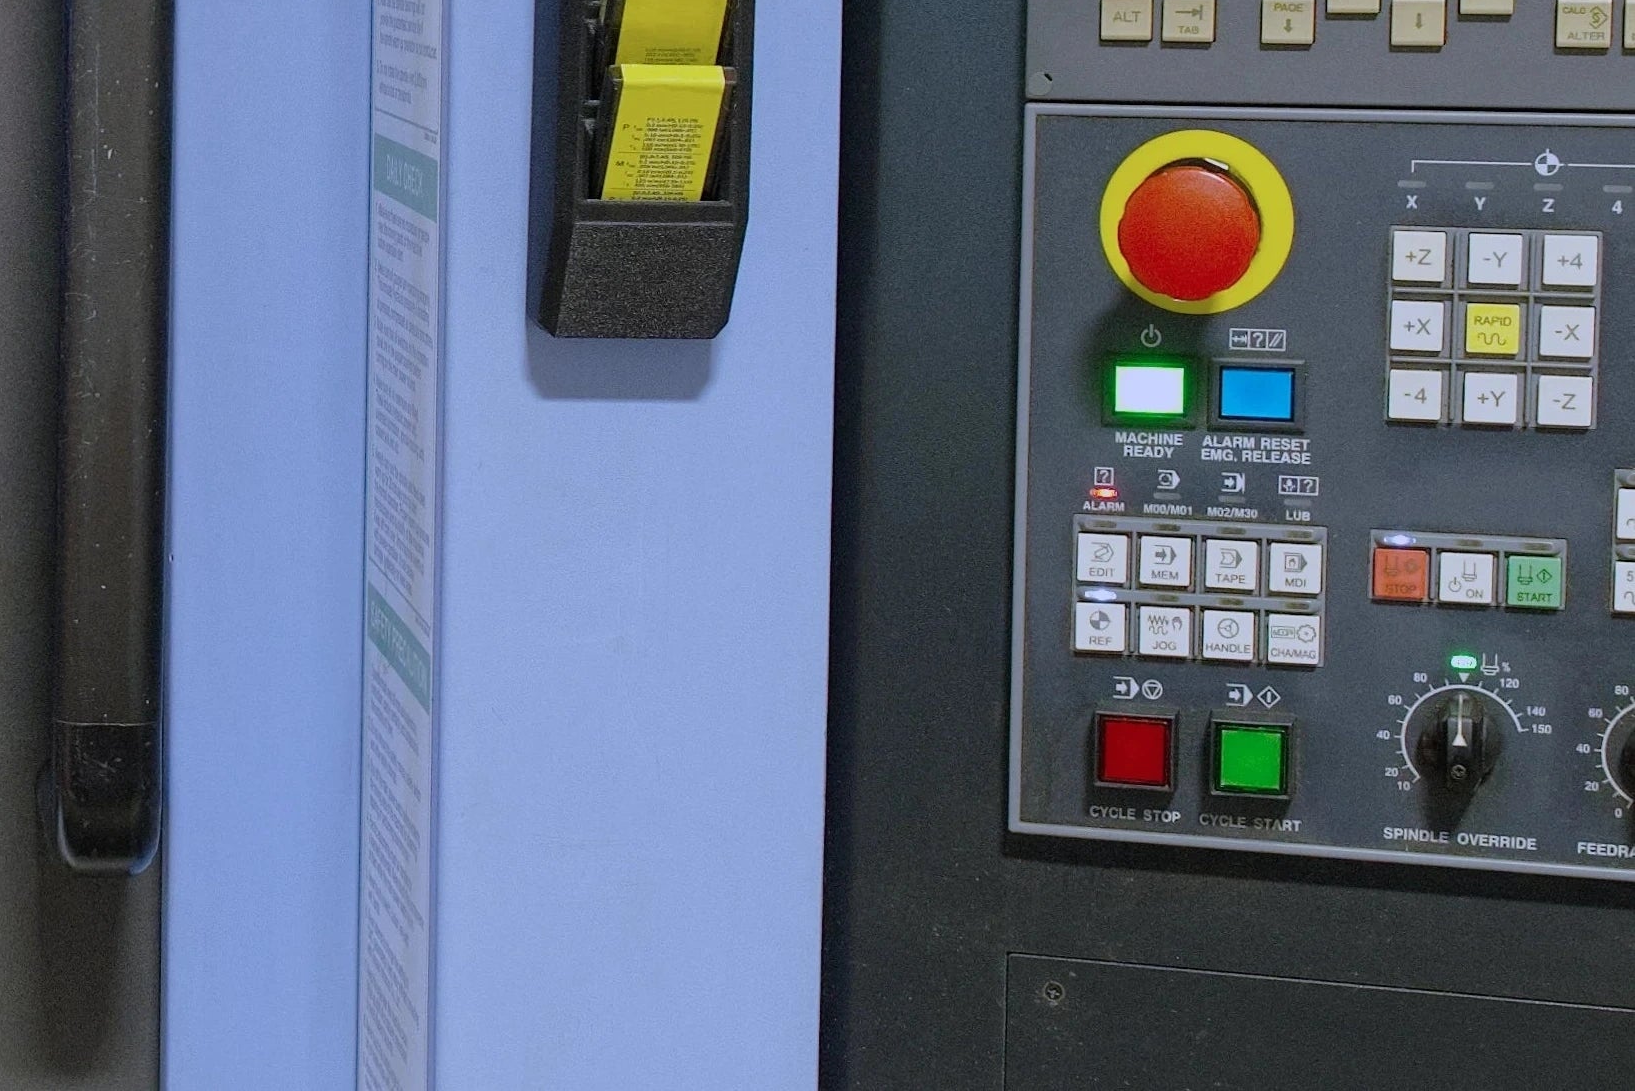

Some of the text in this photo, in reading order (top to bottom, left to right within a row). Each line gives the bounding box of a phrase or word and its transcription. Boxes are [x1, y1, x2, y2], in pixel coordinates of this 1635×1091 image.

[1113, 11, 1141, 23] ALT
[1178, 25, 1200, 34] TAB
[1567, 32, 1605, 41] ALTER
[1406, 195, 1418, 210] X
[1474, 196, 1486, 211] Y
[1542, 198, 1555, 213] Z
[1611, 200, 1623, 214] 4
[1405, 248, 1432, 266] +Z
[1482, 251, 1508, 268] -Y
[1556, 253, 1584, 270] +4
[1403, 318, 1432, 335] +X
[1473, 315, 1512, 327] RAPID
[1554, 324, 1581, 341] -X
[1404, 387, 1427, 404] -4
[1477, 390, 1506, 408] +Y
[1552, 393, 1576, 410] -Z
[1115, 431, 1183, 446] MACHINE
[1202, 434, 1311, 452] ALARM RESET
[1123, 445, 1175, 459] READY
[1201, 448, 1312, 465] EMG. RELEASE
[1083, 501, 1125, 512] ALARM
[1143, 505, 1193, 516] M00/M01
[1207, 507, 1258, 519] M02/M30
[1285, 510, 1311, 522] LUB
[1089, 567, 1115, 577] EDIT
[1151, 569, 1179, 581] MEM
[1215, 573, 1246, 584] TAPE
[1284, 577, 1307, 588] MDI
[1384, 583, 1416, 595] STOP
[1466, 588, 1484, 599] ON
[1517, 592, 1553, 603] START
[1088, 636, 1113, 646] REF
[1152, 640, 1177, 651] JOG
[1206, 643, 1251, 654] HANDLE
[1413, 672, 1427, 683] 80
[1499, 678, 1519, 689] 120
[1388, 695, 1402, 705] 60
[1526, 706, 1546, 716] 140
[1376, 730, 1391, 740] 40
[1531, 724, 1552, 734] 150
[1576, 743, 1591, 754] 40
[1384, 767, 1399, 777] 20
[1397, 781, 1410, 791] 10
[1584, 781, 1599, 792] 20
[1089, 805, 1182, 823] CYCLE STOP
[1614, 808, 1623, 818] 0
[1199, 813, 1303, 832] CYCLE START
[1383, 826, 1538, 851] SPINDLE OVERRIDE
